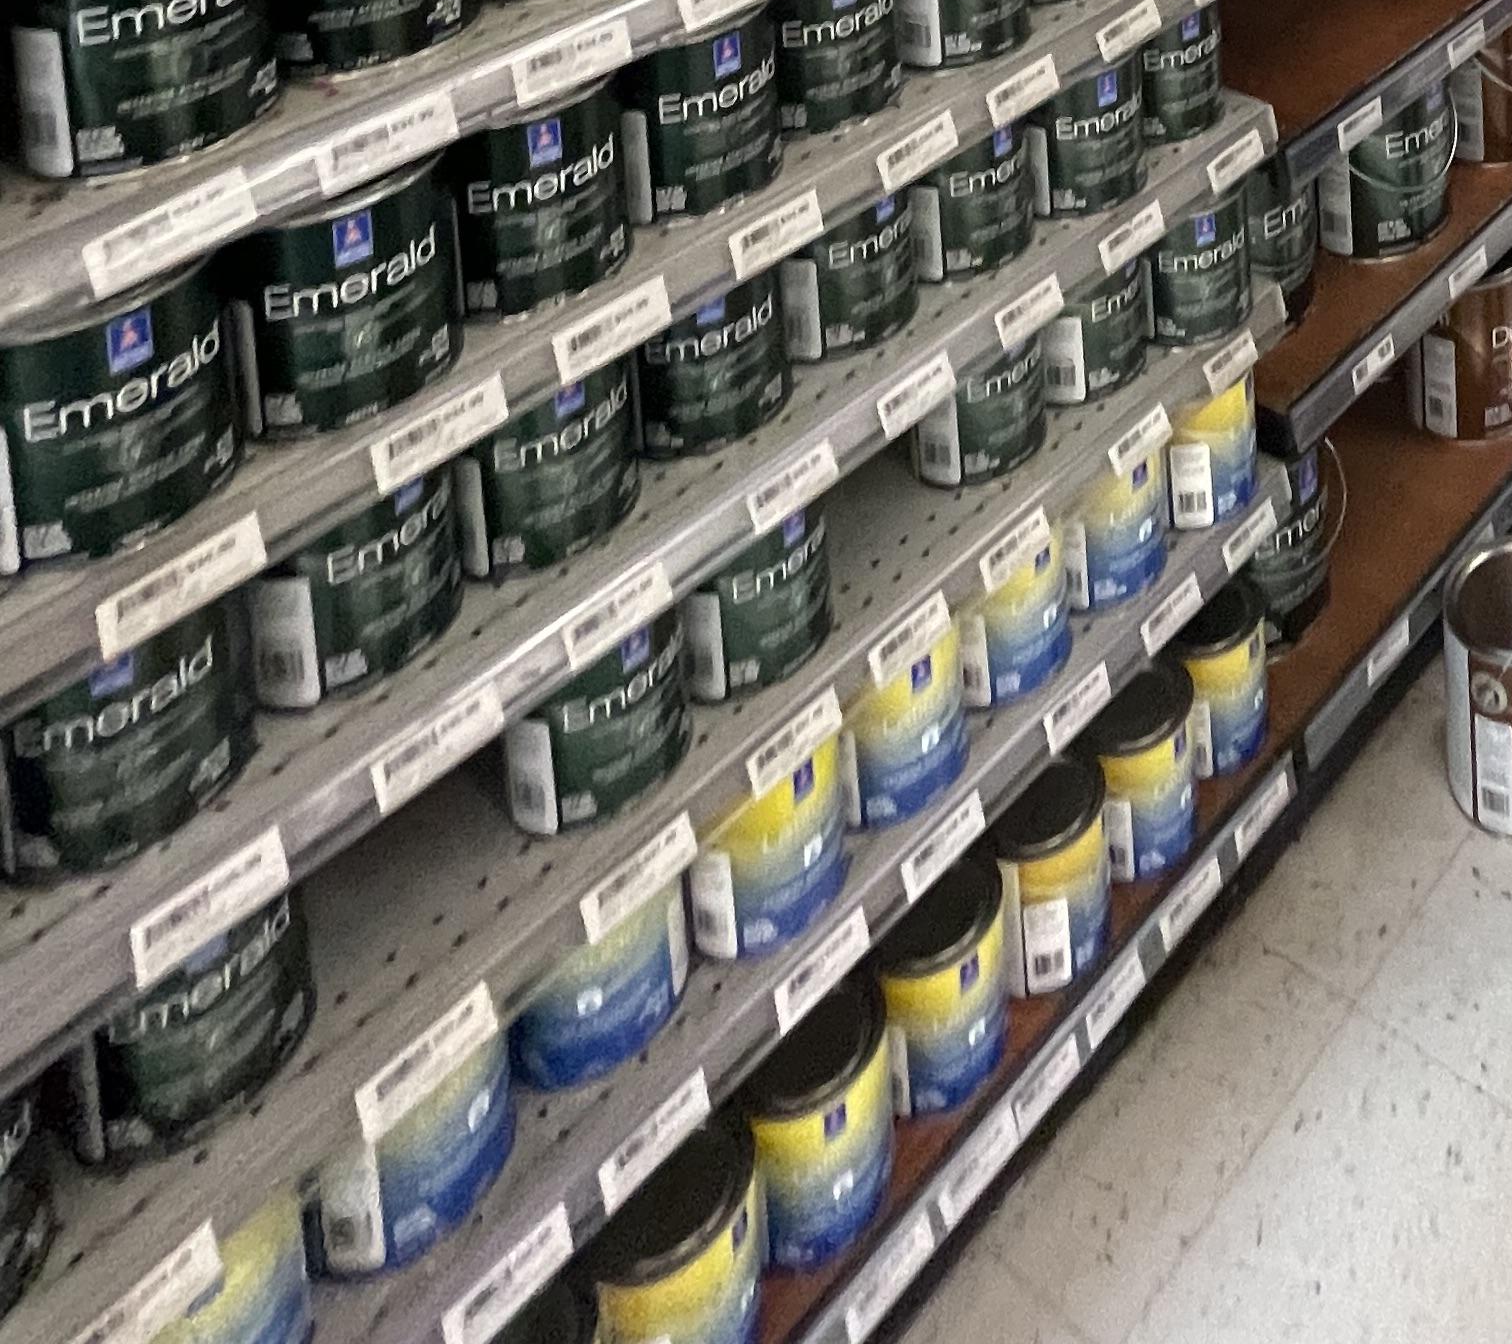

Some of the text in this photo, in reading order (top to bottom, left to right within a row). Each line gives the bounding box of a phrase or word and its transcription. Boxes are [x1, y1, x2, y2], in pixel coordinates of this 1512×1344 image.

[658, 41, 776, 125] Emerald
[467, 132, 615, 214] Emerald
[263, 224, 436, 322] Emerald
[23, 320, 221, 444] Emerald
